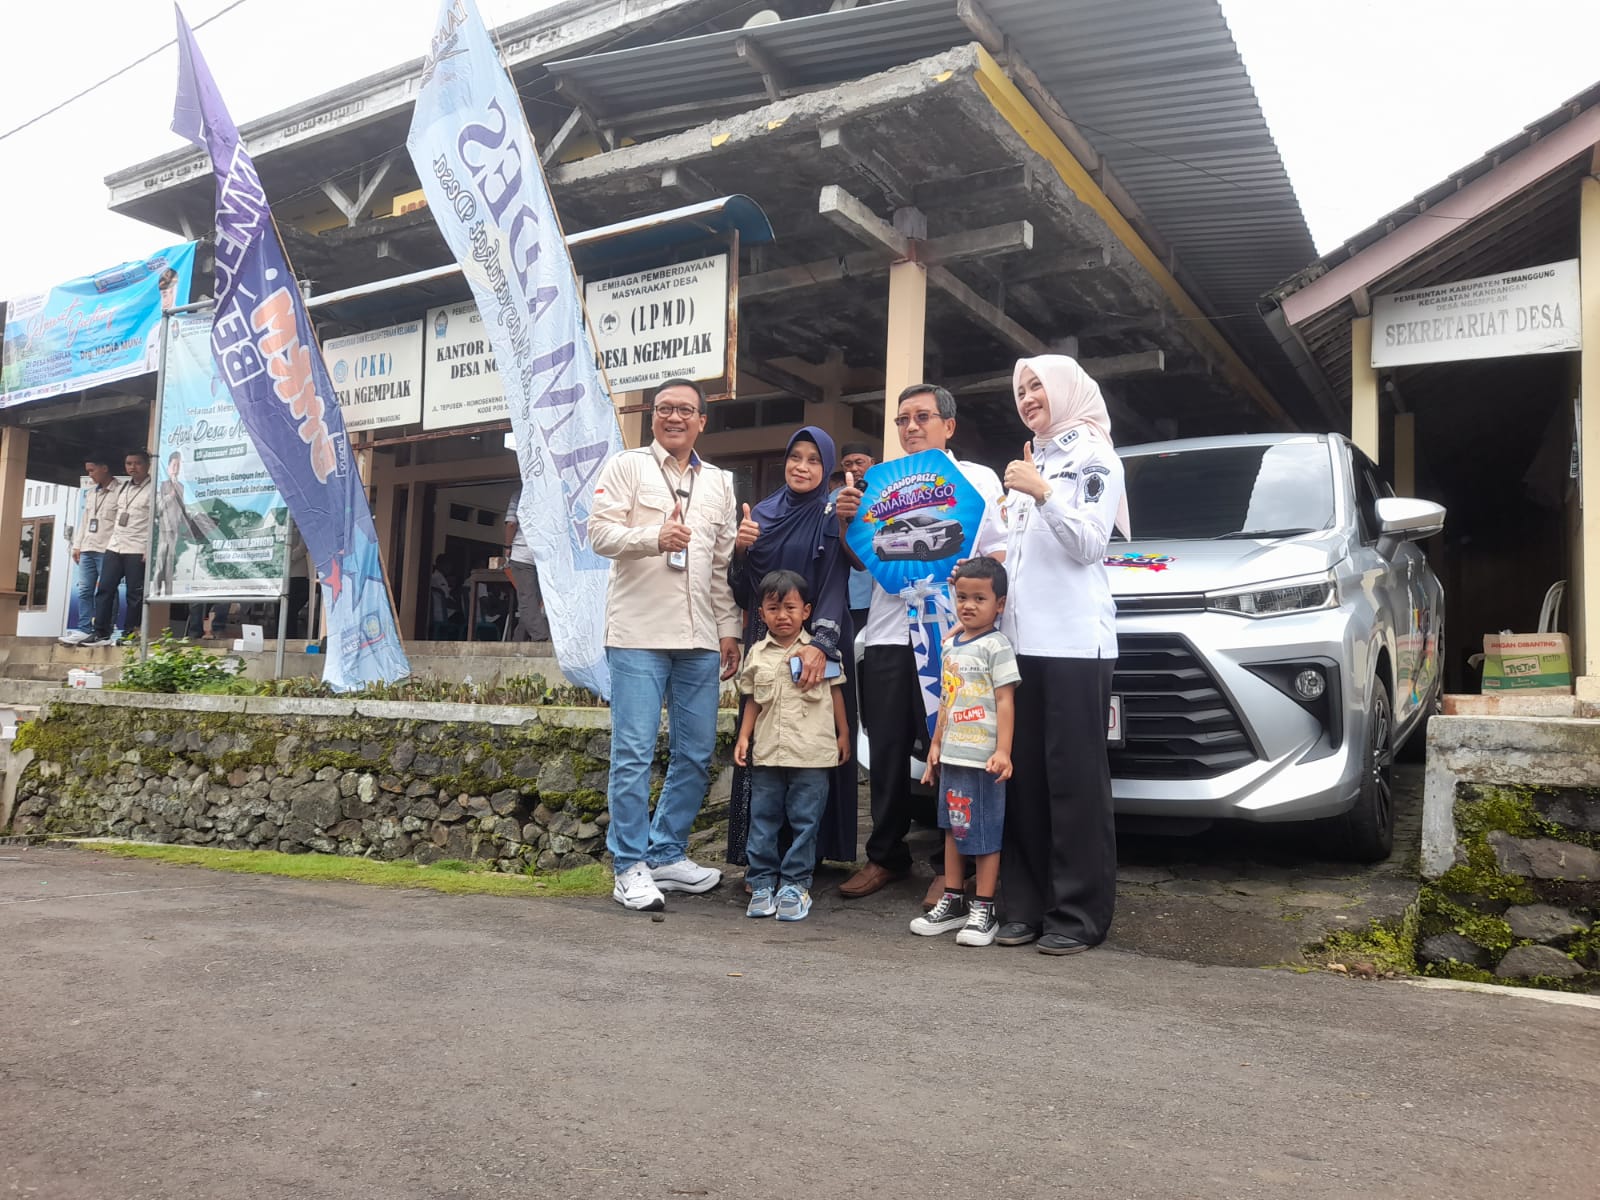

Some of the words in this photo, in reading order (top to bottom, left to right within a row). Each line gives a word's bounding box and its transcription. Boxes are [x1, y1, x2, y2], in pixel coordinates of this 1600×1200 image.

[597, 277, 639, 292] LEMBAGA
[641, 260, 715, 281] PEMBERDAYAAN
[612, 281, 671, 300] MASYARAKAT
[673, 275, 698, 288] DESA
[1394, 287, 1447, 303] PEMERINTAH
[1449, 279, 1500, 294] KABUPATEN
[1502, 269, 1556, 285] TEMANGGUNG
[1418, 292, 1470, 307] KECAMATAN
[1472, 283, 1527, 299] KANDANGAN
[1436, 301, 1459, 312] DESA
[1385, 309, 1509, 347] SEKRETARIAT
[1516, 302, 1565, 332] DESA
[436, 340, 484, 362] KANTOR
[595, 347, 628, 371] DESA
[633, 332, 712, 365] NGEMPLAK
[451, 361, 480, 379] DESA
[619, 375, 648, 384] KANDANGAN
[661, 366, 695, 378] TEMANGGUNG
[335, 391, 351, 408] ESA
[354, 380, 411, 408] NGEMPLAK
[187, 405, 216, 416] Selamat
[193, 420, 226, 442] Desa
[232, 486, 250, 494] untuk
[881, 473, 937, 498] GRANDPRIZE
[870, 489, 932, 517] SIMARMAS
[934, 485, 954, 498] GO
